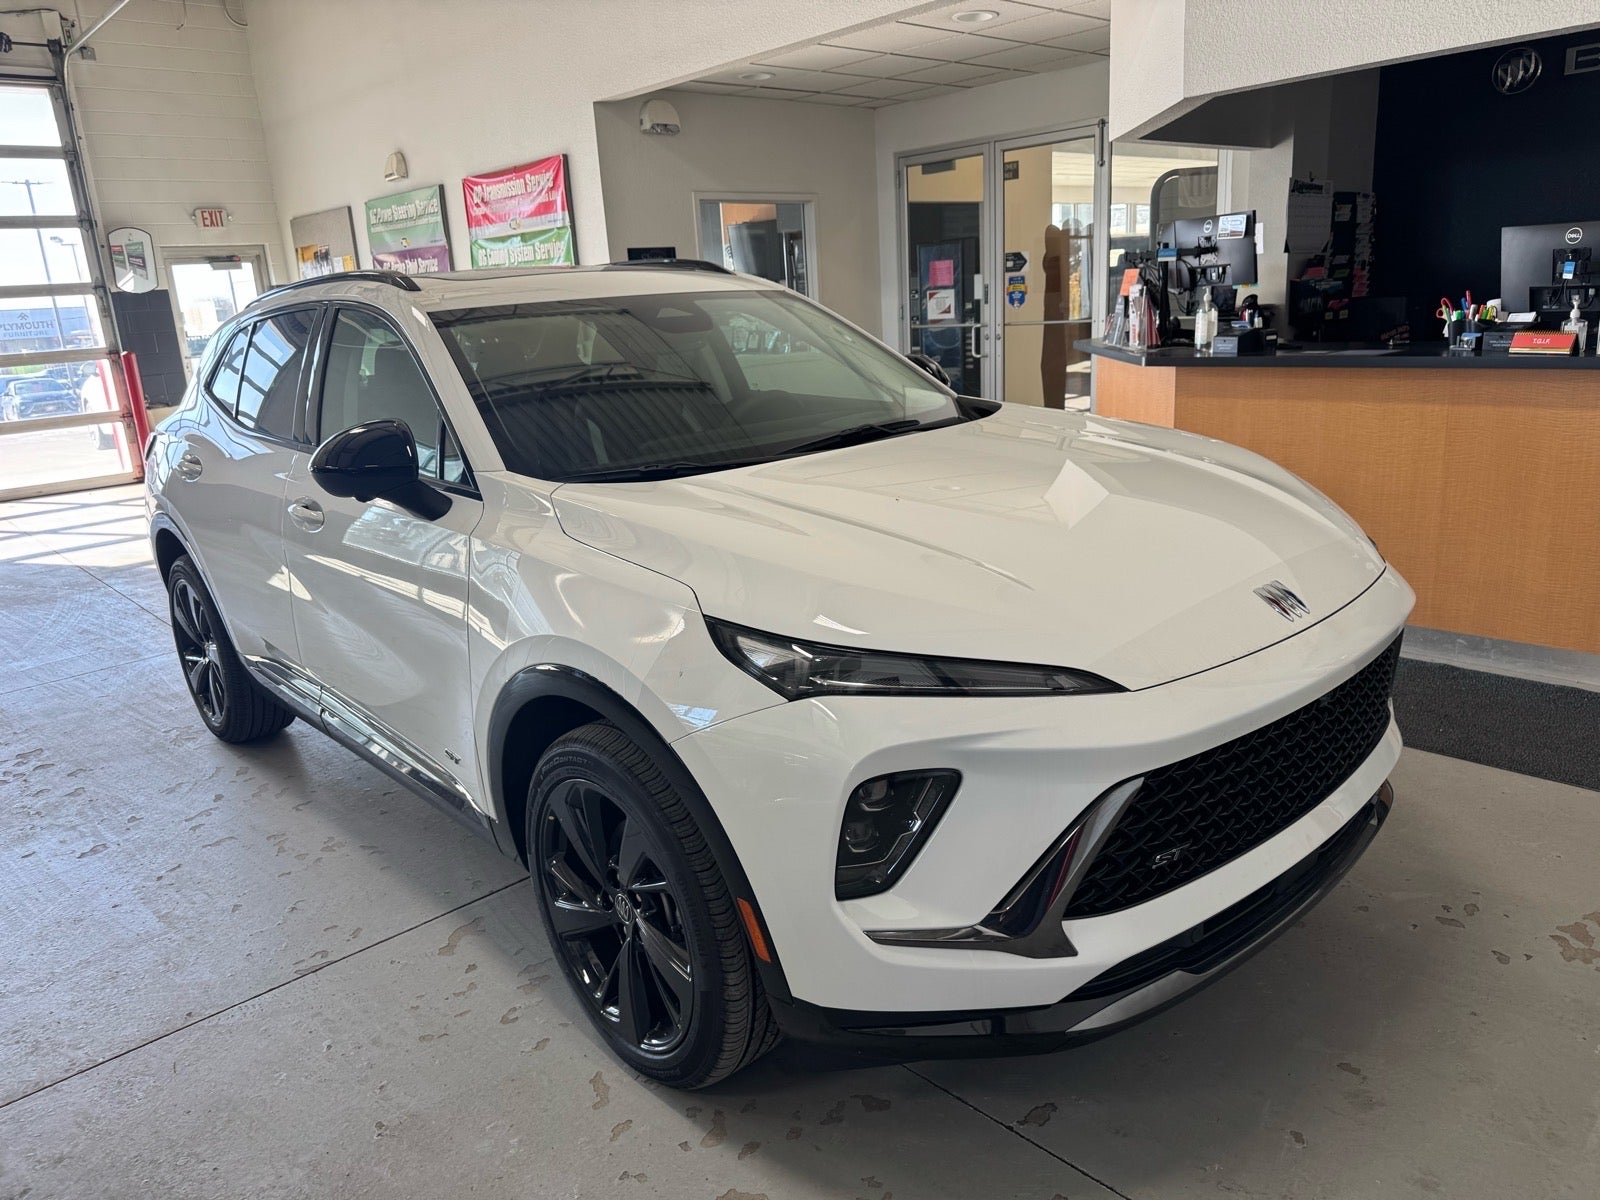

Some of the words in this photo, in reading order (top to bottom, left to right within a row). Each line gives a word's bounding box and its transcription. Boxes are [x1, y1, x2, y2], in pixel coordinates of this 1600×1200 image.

[481, 176, 526, 202] Transmission
[525, 169, 554, 193] Service
[200, 210, 224, 227] EXIT
[376, 207, 394, 224] Power
[391, 201, 418, 222] Steering
[415, 198, 439, 218] Service
[418, 256, 439, 273] Service
[508, 243, 535, 266] System
[534, 238, 564, 260] Service
